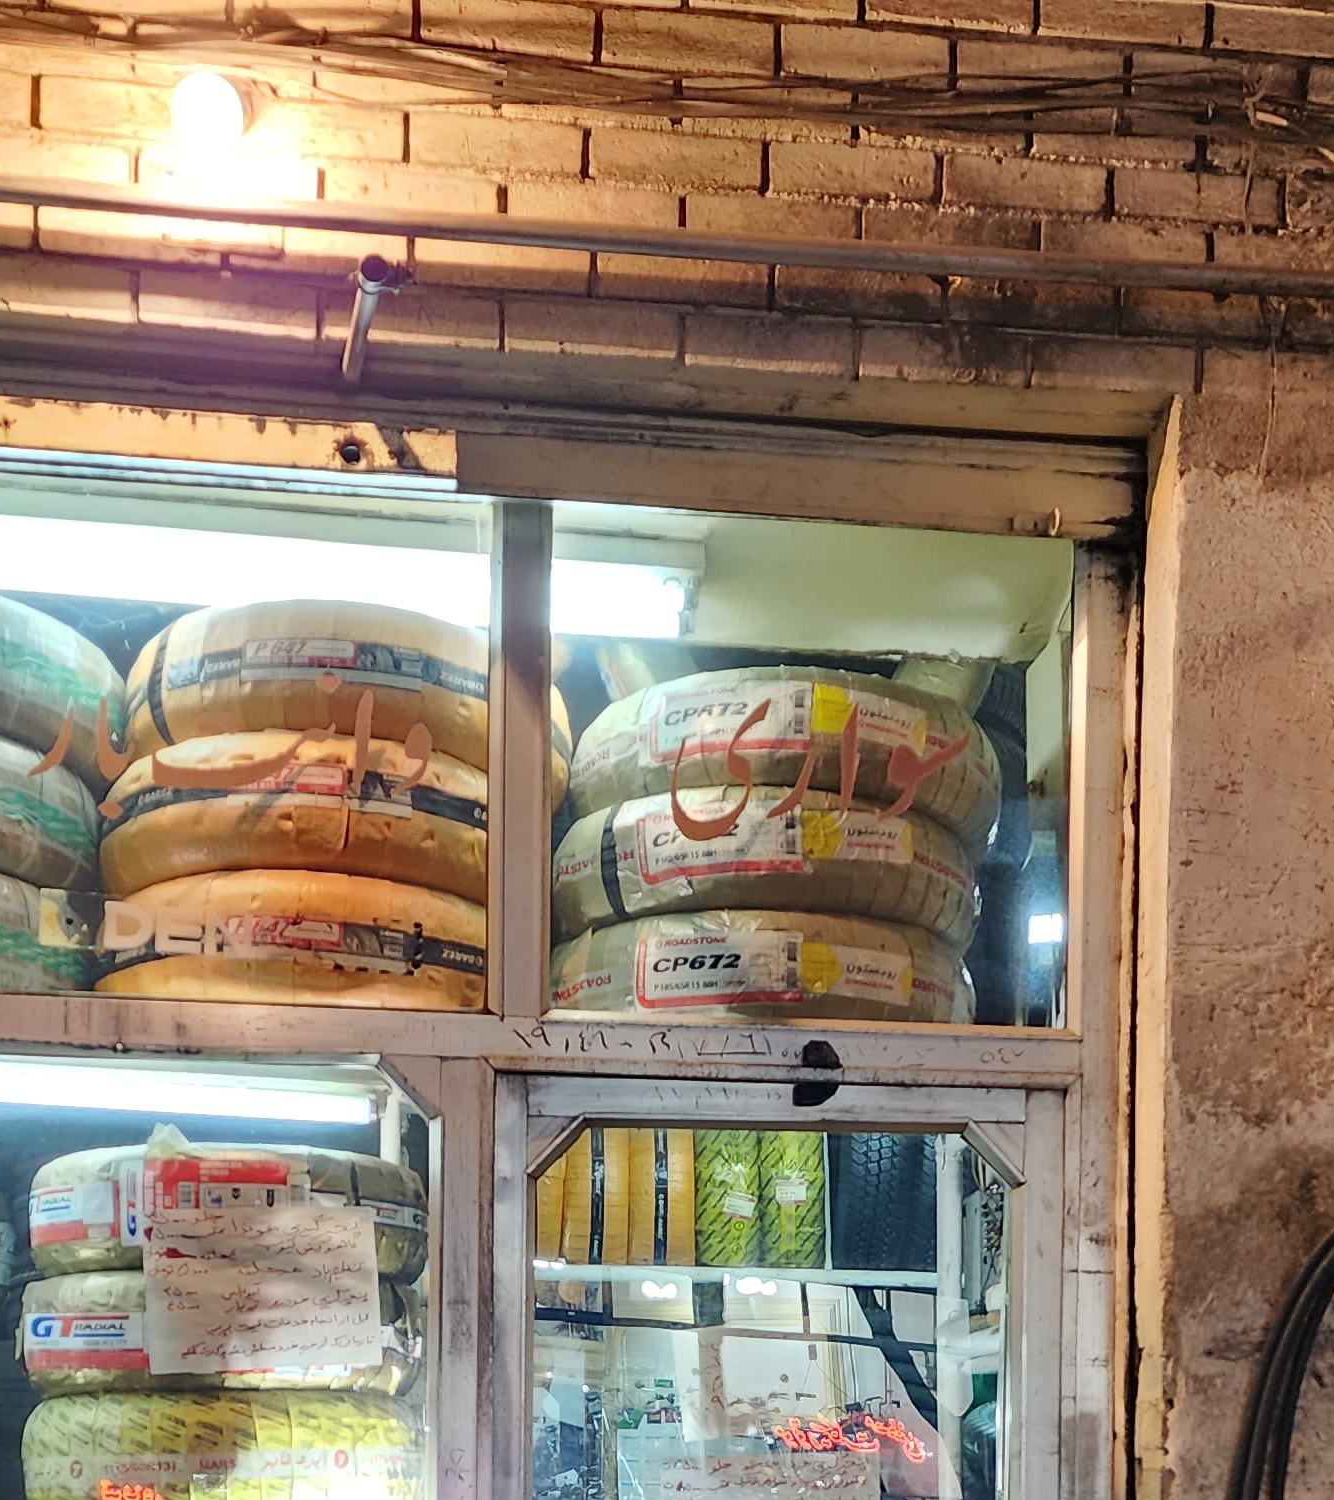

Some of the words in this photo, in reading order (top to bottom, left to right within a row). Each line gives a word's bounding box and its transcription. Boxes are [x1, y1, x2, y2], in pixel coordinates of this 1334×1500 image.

[652, 823, 740, 848] CP2
[663, 936, 728, 949] ROADSTONE
[652, 953, 742, 973] CP672
[74, 1322, 127, 1332] RADIAL
